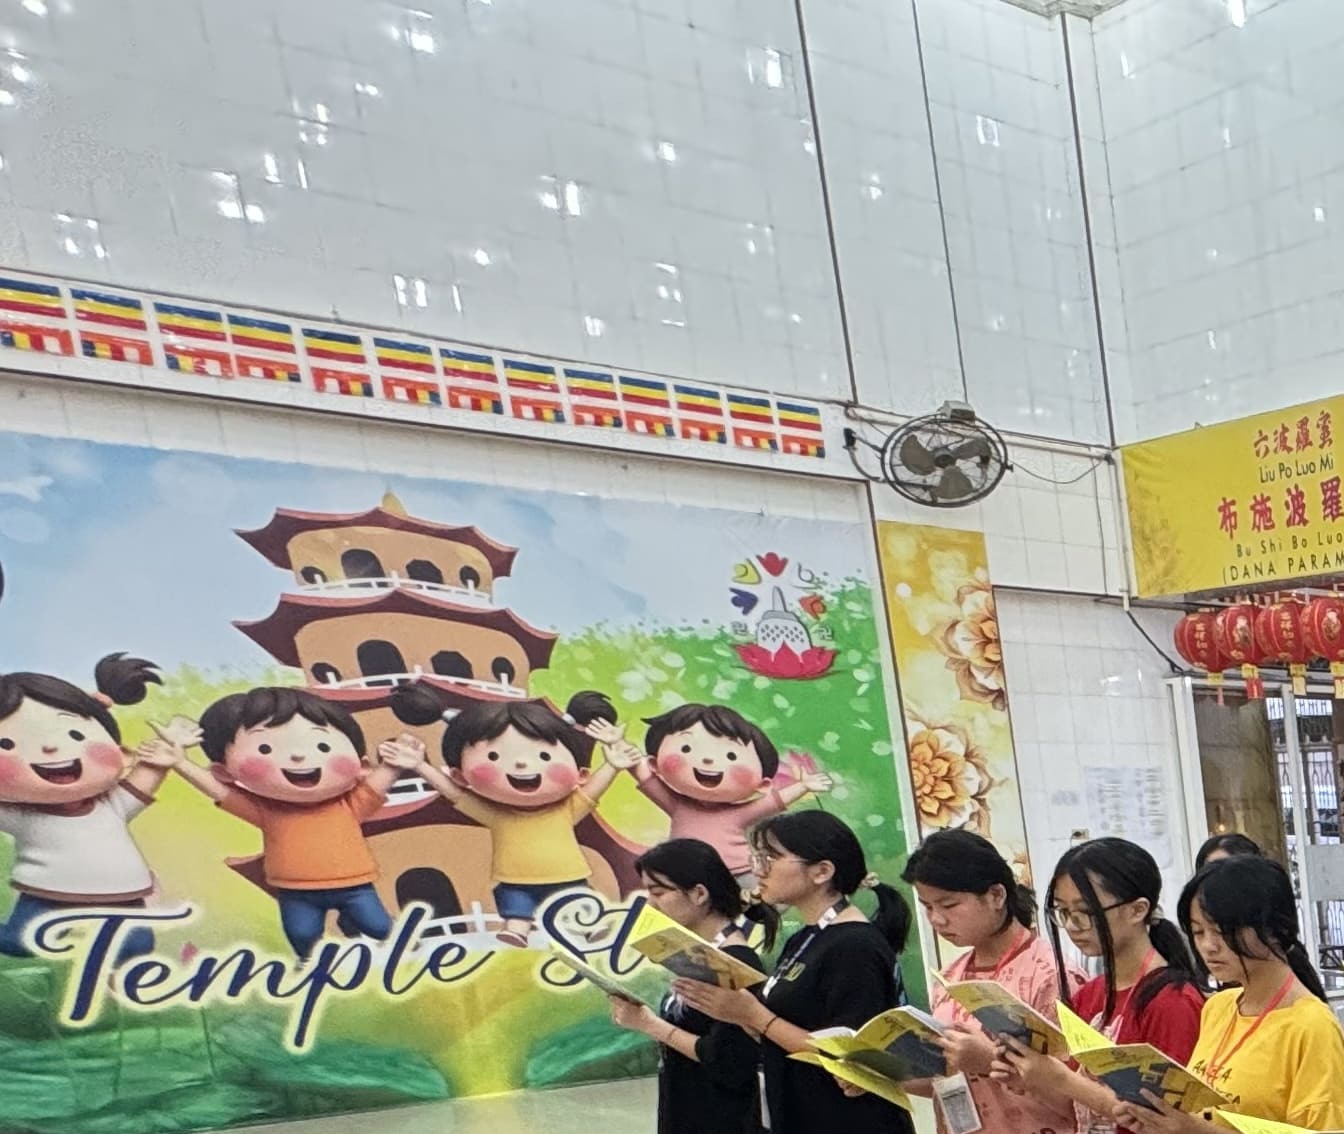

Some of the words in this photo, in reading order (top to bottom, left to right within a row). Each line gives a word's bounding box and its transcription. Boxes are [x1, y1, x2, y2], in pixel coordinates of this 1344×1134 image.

[1259, 465, 1276, 484] Liu
[1295, 459, 1316, 476] Luo
[1319, 452, 1334, 472] Mi
[1260, 538, 1283, 554] Shi
[1291, 535, 1308, 550] Bo
[1317, 531, 1343, 546] Luo
[1223, 560, 1277, 586] (DANA
[34, 900, 496, 1048] Temple
[539, 892, 660, 987] St
